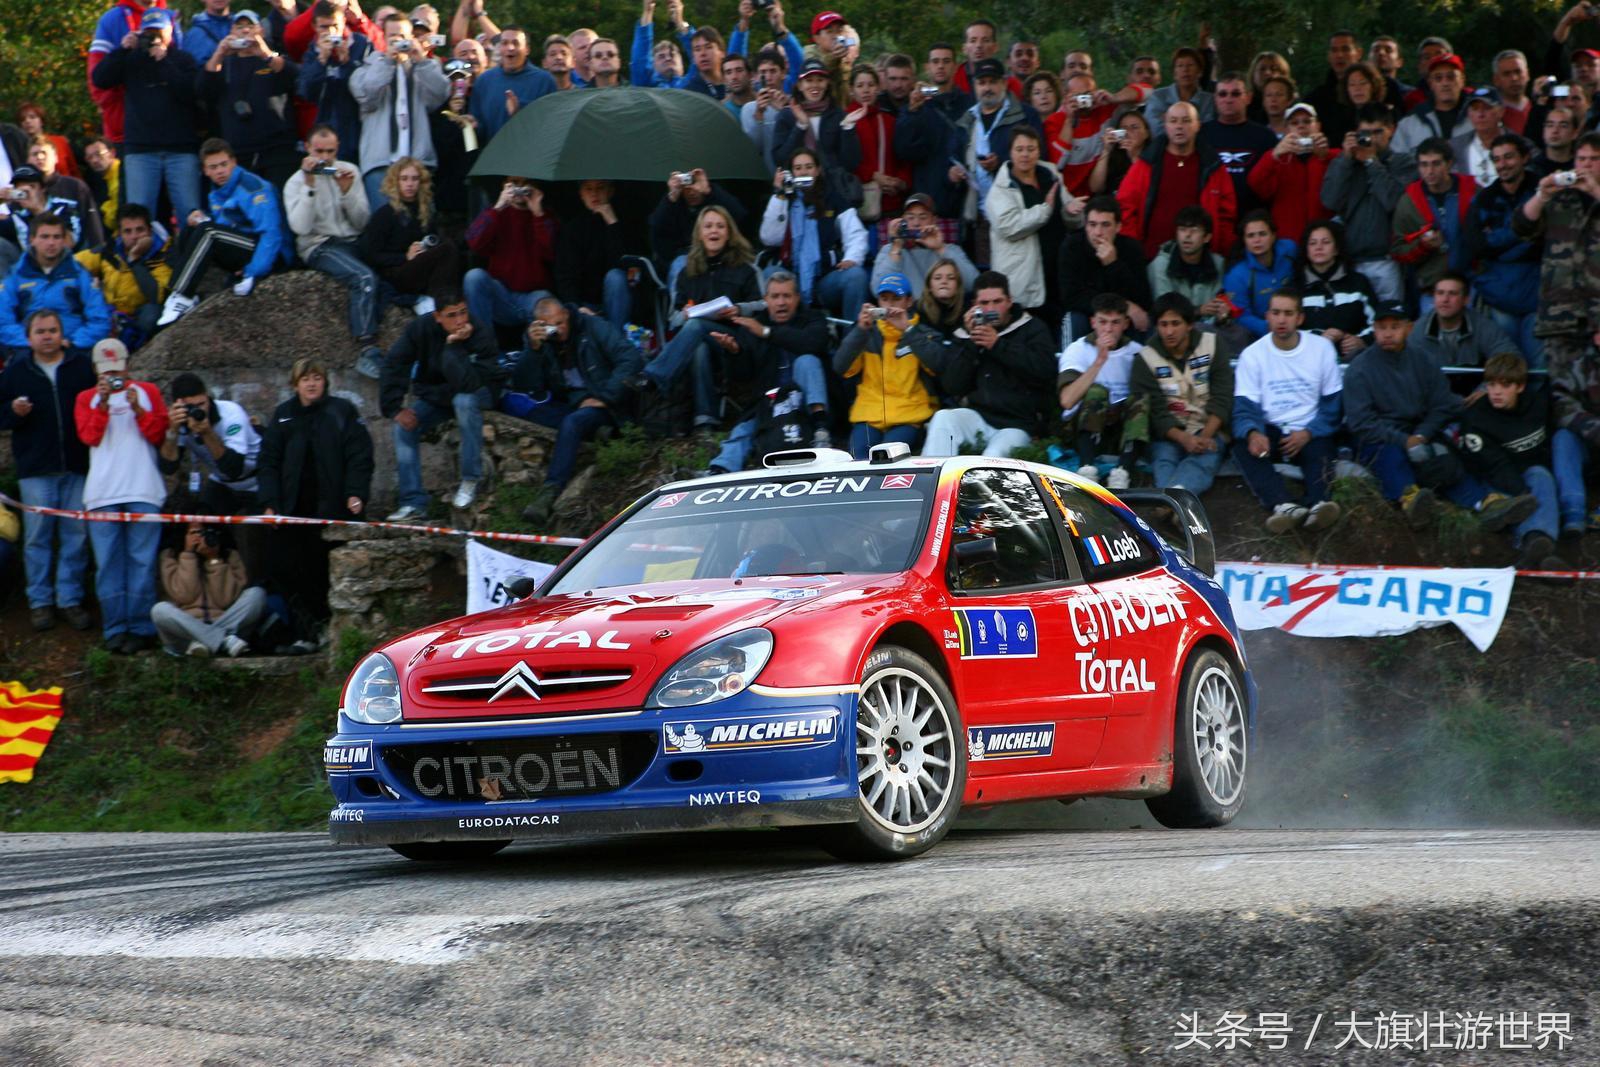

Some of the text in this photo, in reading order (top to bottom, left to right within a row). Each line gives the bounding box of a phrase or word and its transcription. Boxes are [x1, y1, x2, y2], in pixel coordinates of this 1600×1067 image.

[694, 475, 871, 505] CITROËN
[1102, 530, 1141, 562] Loeb
[452, 629, 631, 659] TOTAL
[1075, 652, 1155, 692] TOTAL
[710, 719, 833, 742] MICHELIN
[987, 731, 1053, 751] MICHELIN
[413, 742, 620, 797] CITROËN
[690, 789, 761, 806] NAVTEQ
[458, 815, 560, 828] EURODATACAR
